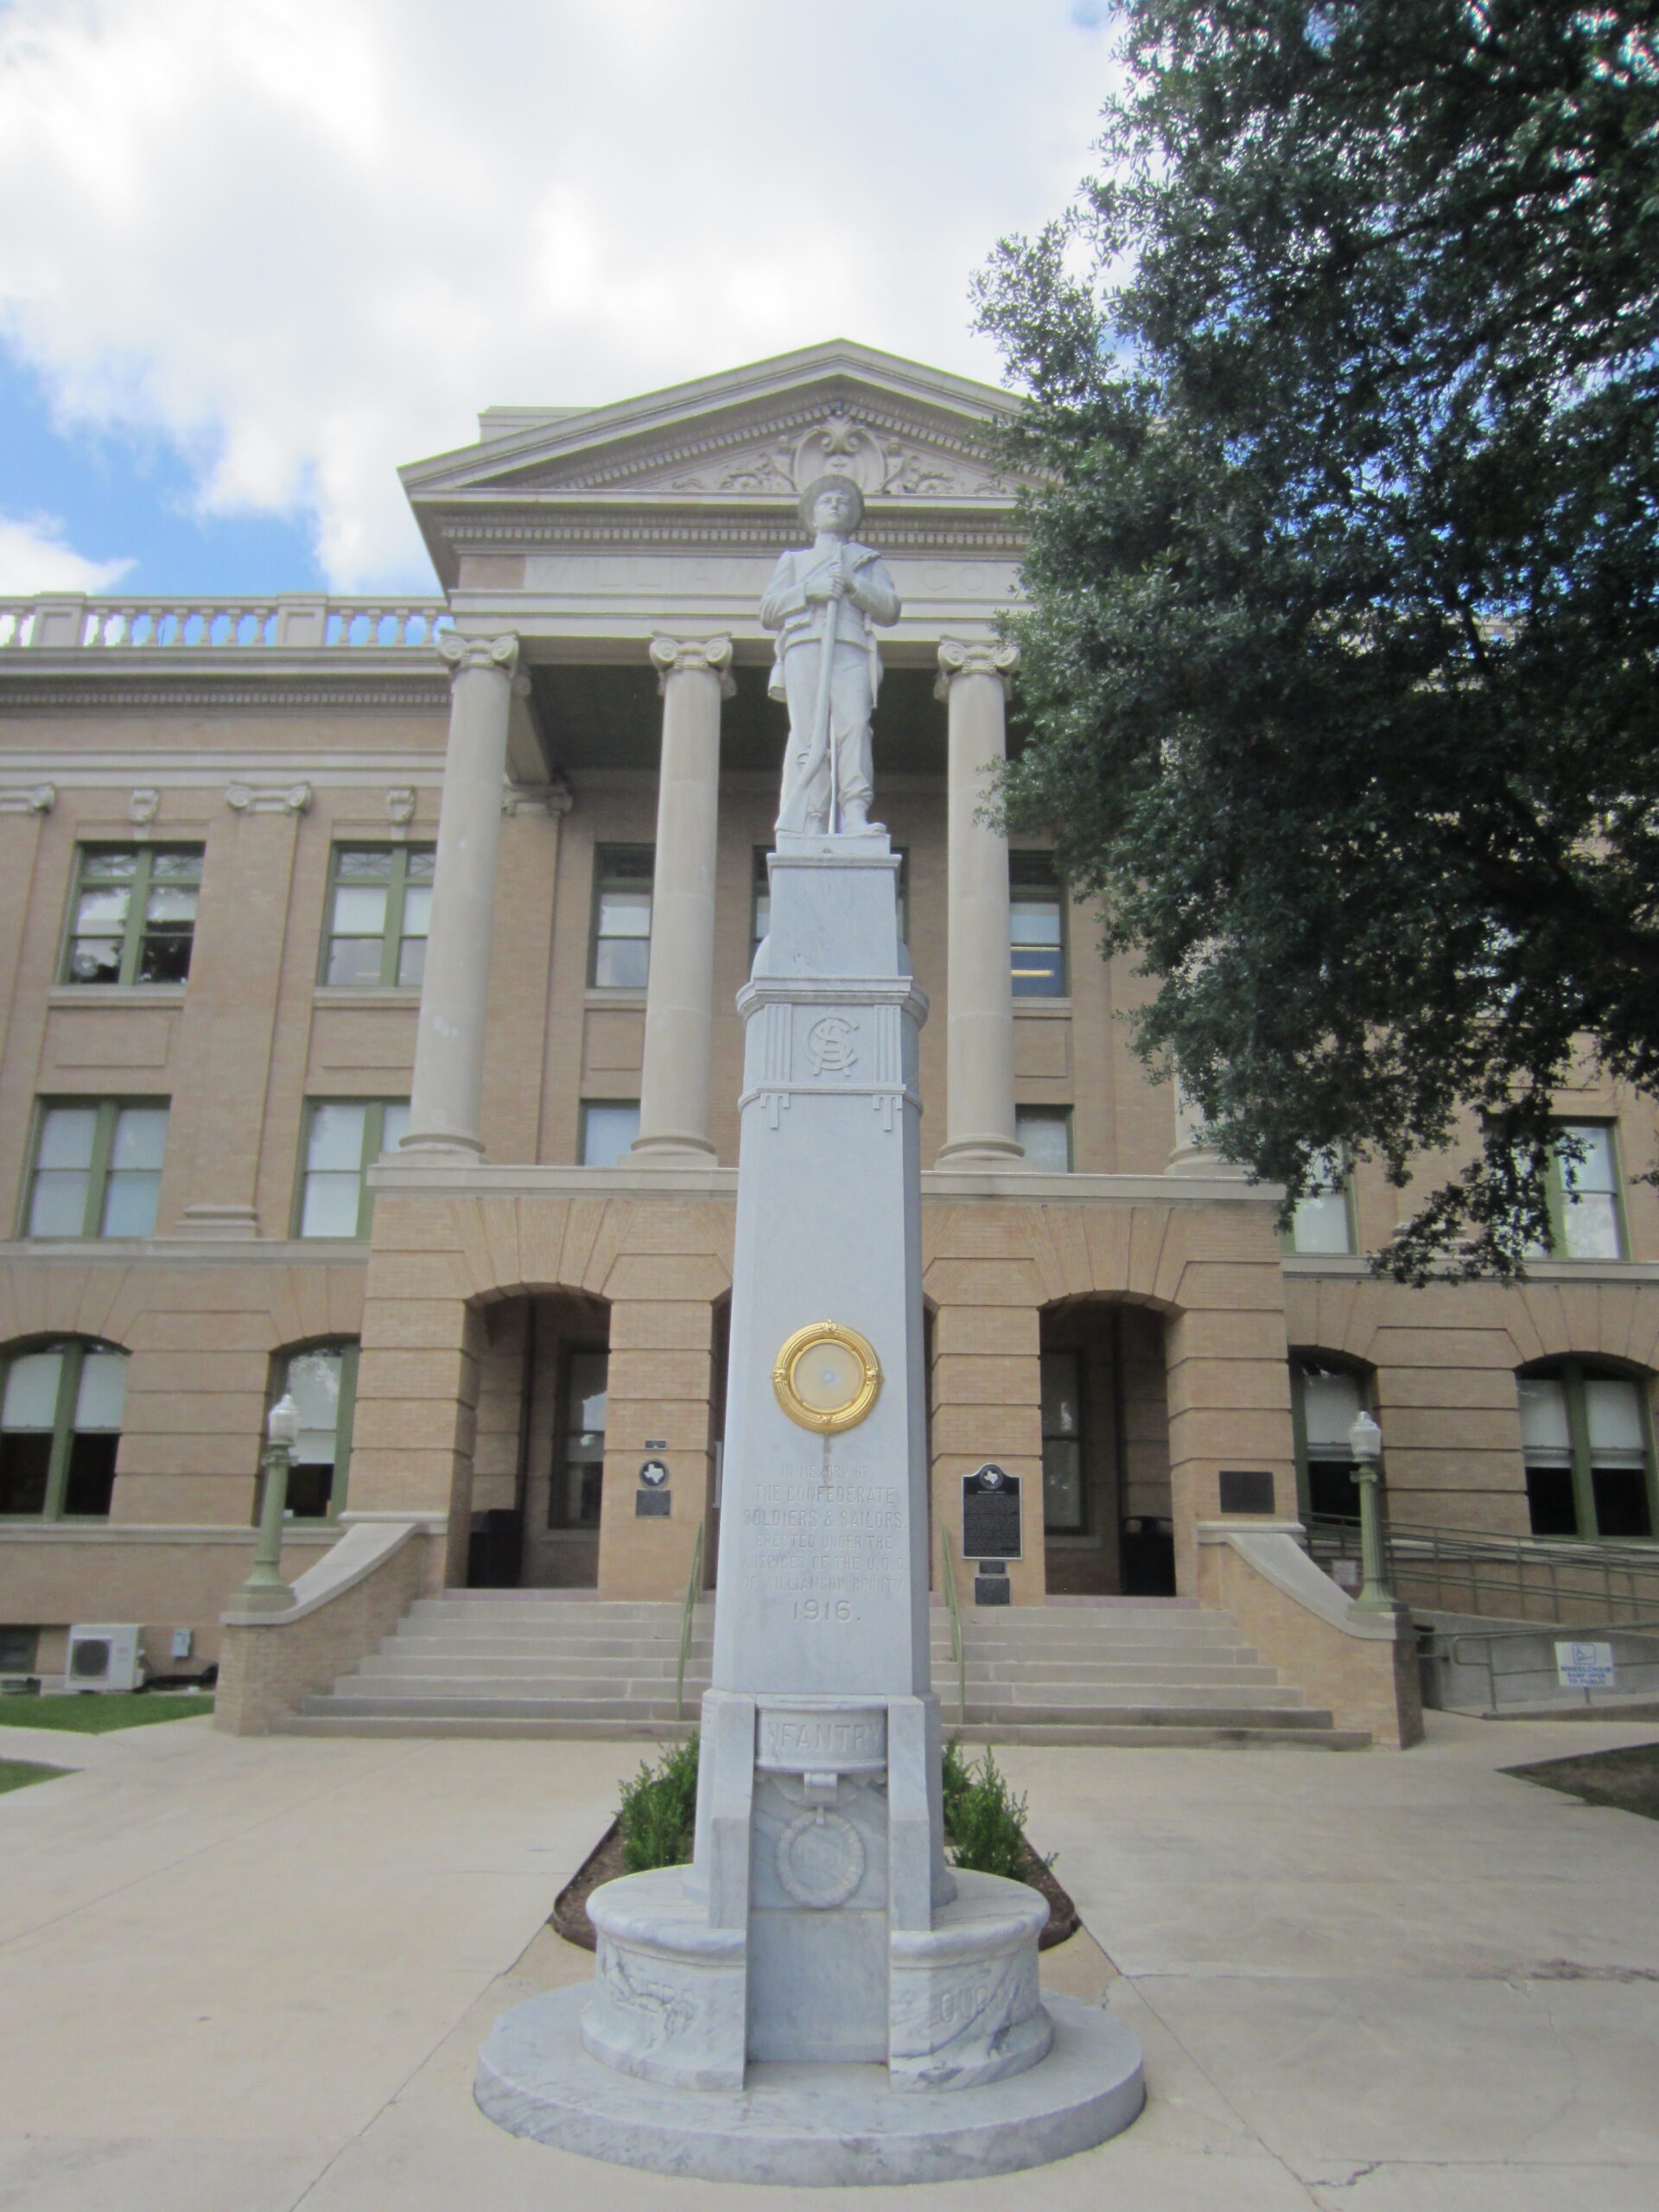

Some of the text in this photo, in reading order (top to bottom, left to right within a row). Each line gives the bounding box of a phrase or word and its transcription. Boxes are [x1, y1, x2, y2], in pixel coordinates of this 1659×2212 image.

[531, 560, 767, 588] WILLIAM
[781, 1465, 870, 1480] IN MEMORY OF
[753, 1484, 895, 1504] THE CONFEDERATE
[743, 1509, 903, 1529] SOLDIERS & SAILORS
[754, 1534, 893, 1550] ERECTED UNDER THE
[740, 1554, 807, 1570] AUSPICES
[811, 1555, 827, 1569] OF
[834, 1556, 861, 1571] THE
[741, 1575, 906, 1595] OF WILLIAMSON COUNTY
[765, 1721, 882, 1751] NFANTRY
